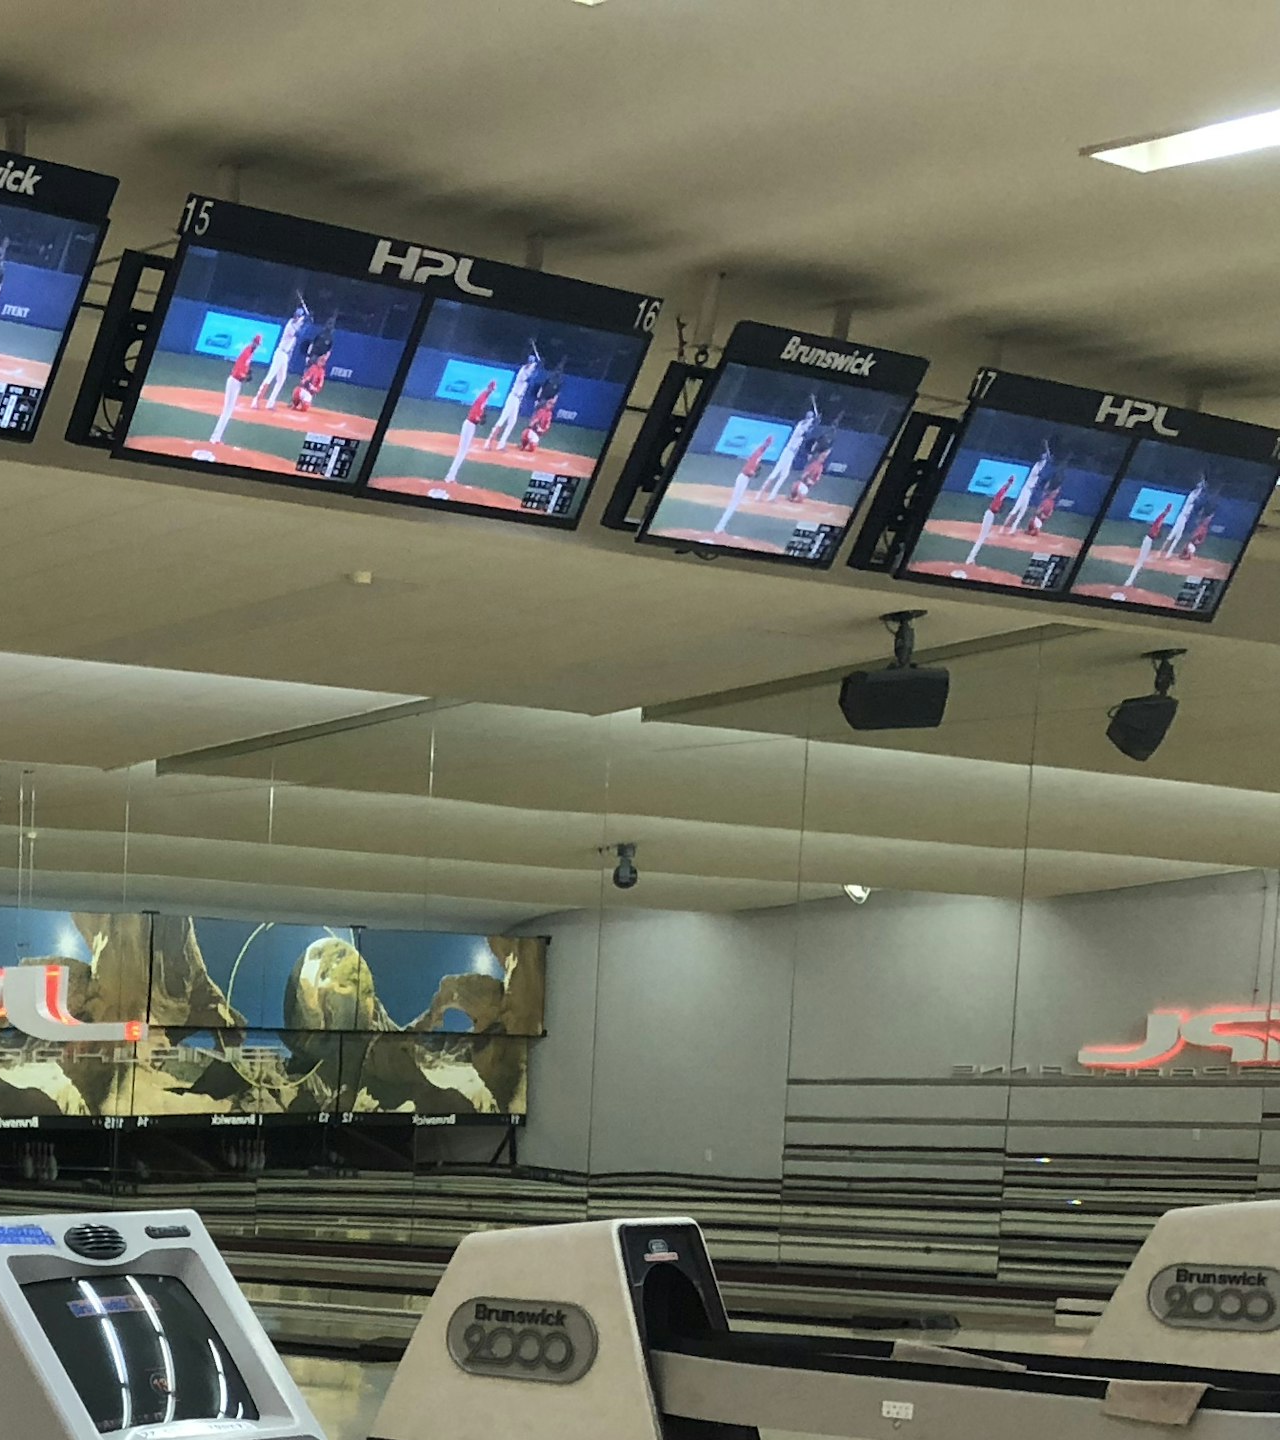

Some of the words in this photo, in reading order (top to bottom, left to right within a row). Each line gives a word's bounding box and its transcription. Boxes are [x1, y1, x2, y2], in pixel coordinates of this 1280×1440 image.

[184, 198, 214, 236] 15
[368, 239, 493, 297] HPL
[633, 298, 661, 333] 16
[780, 336, 877, 378] Brunswick
[974, 369, 998, 398] 17
[1095, 394, 1179, 437] HPL
[1176, 1268, 1268, 1287] Brunswick
[474, 1303, 568, 1327] Brunswick
[1163, 1284, 1277, 1324] 2000
[463, 1323, 576, 1374] 2000
